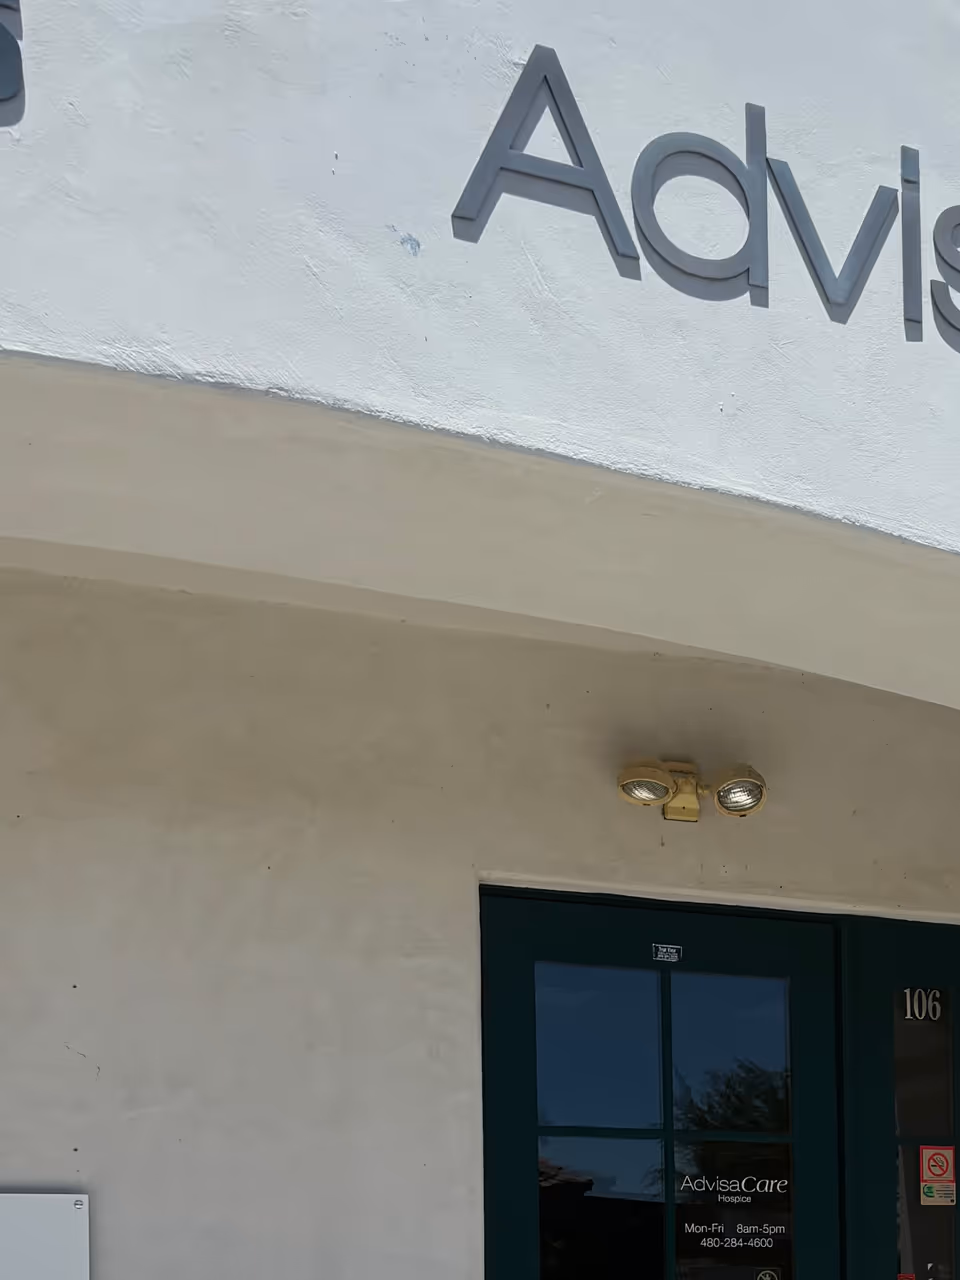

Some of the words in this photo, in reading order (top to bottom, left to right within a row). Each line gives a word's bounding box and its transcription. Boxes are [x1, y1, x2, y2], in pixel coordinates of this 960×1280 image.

[904, 988, 941, 1020] 106
[680, 1176, 788, 1193] AdvisaCare
[718, 1194, 752, 1204] Hospice
[684, 1223, 724, 1233] Mon-Fri
[736, 1223, 785, 1235] 8am-5pm
[700, 1237, 773, 1248] 480-284-4600
